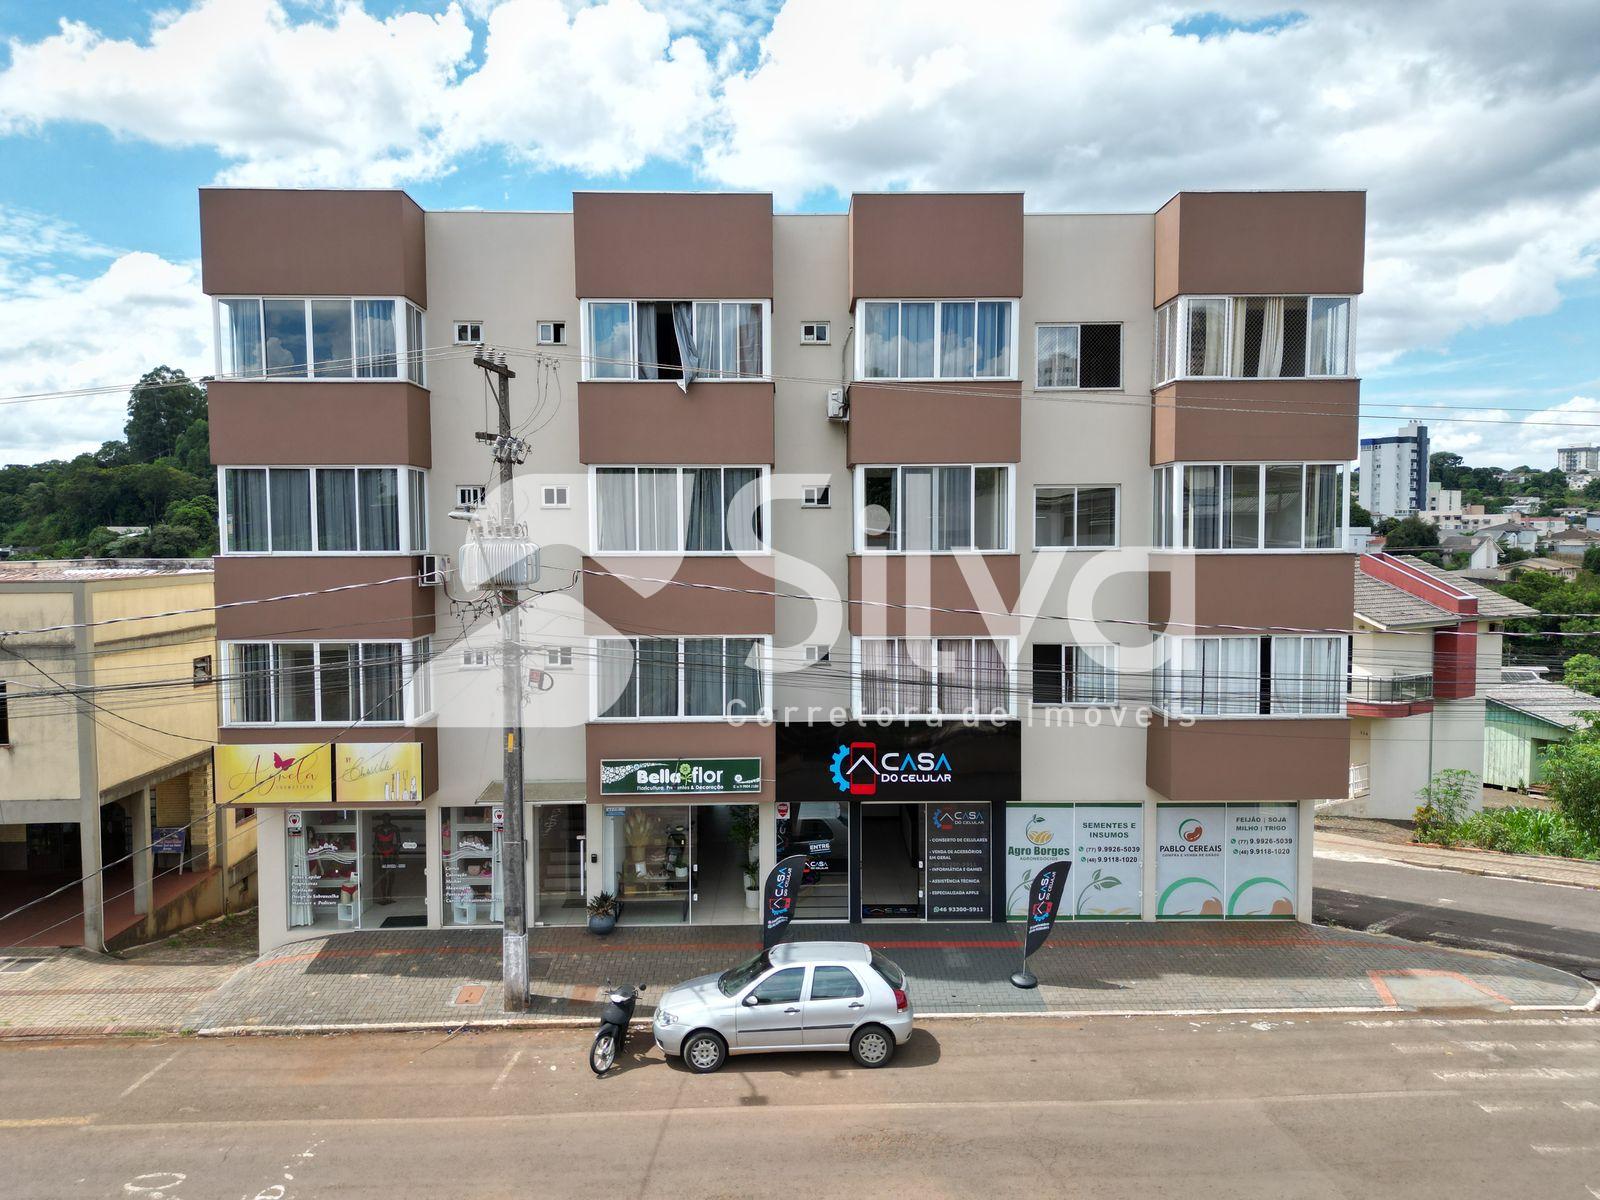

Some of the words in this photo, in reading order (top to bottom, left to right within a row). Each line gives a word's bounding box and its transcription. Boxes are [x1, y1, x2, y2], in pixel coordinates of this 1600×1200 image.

[881, 752, 952, 771] CASA
[636, 768, 681, 784] Bella
[692, 766, 724, 784] flor
[881, 773, 899, 783] DO
[900, 773, 952, 783] CELULAR
[954, 811, 984, 820] CASA
[1236, 815, 1261, 823] FEIJÃO
[809, 842, 831, 851] ENTRE
[1007, 846, 1032, 856] Agro
[1033, 846, 1070, 856] Borges
[1159, 845, 1185, 853] PABLO
[1188, 844, 1222, 853] CEREAIS
[775, 866, 787, 896] CASA
[1038, 871, 1051, 900] CASA
